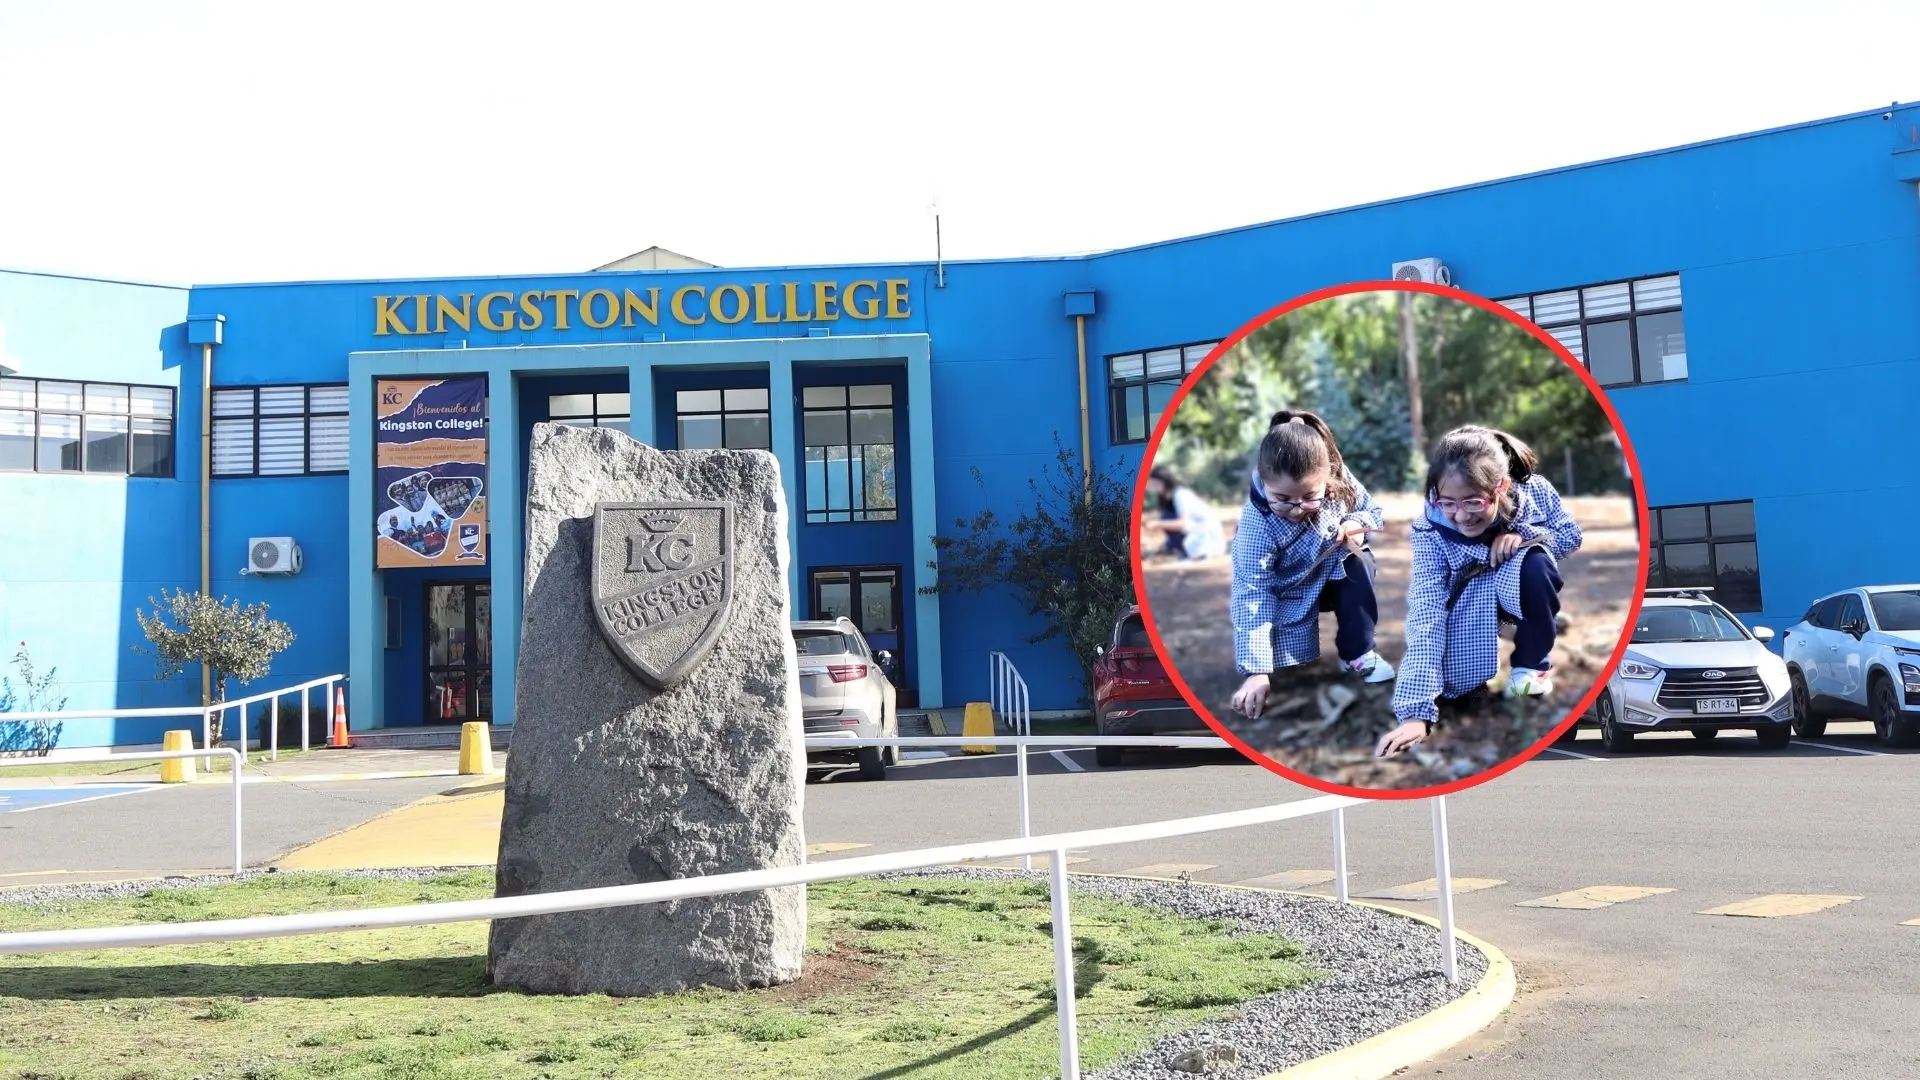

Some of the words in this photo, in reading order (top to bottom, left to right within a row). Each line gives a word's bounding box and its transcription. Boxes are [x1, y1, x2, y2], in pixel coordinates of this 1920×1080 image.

[373, 287, 660, 336] KINGSTON
[670, 278, 912, 325] COLLEGE
[382, 392, 403, 405] KC
[470, 402, 481, 413] al
[380, 420, 432, 432] Kingston
[435, 419, 483, 433] College!
[624, 533, 695, 573] KC
[602, 567, 724, 621] KINGSTON
[613, 588, 722, 636] COLLEGE
